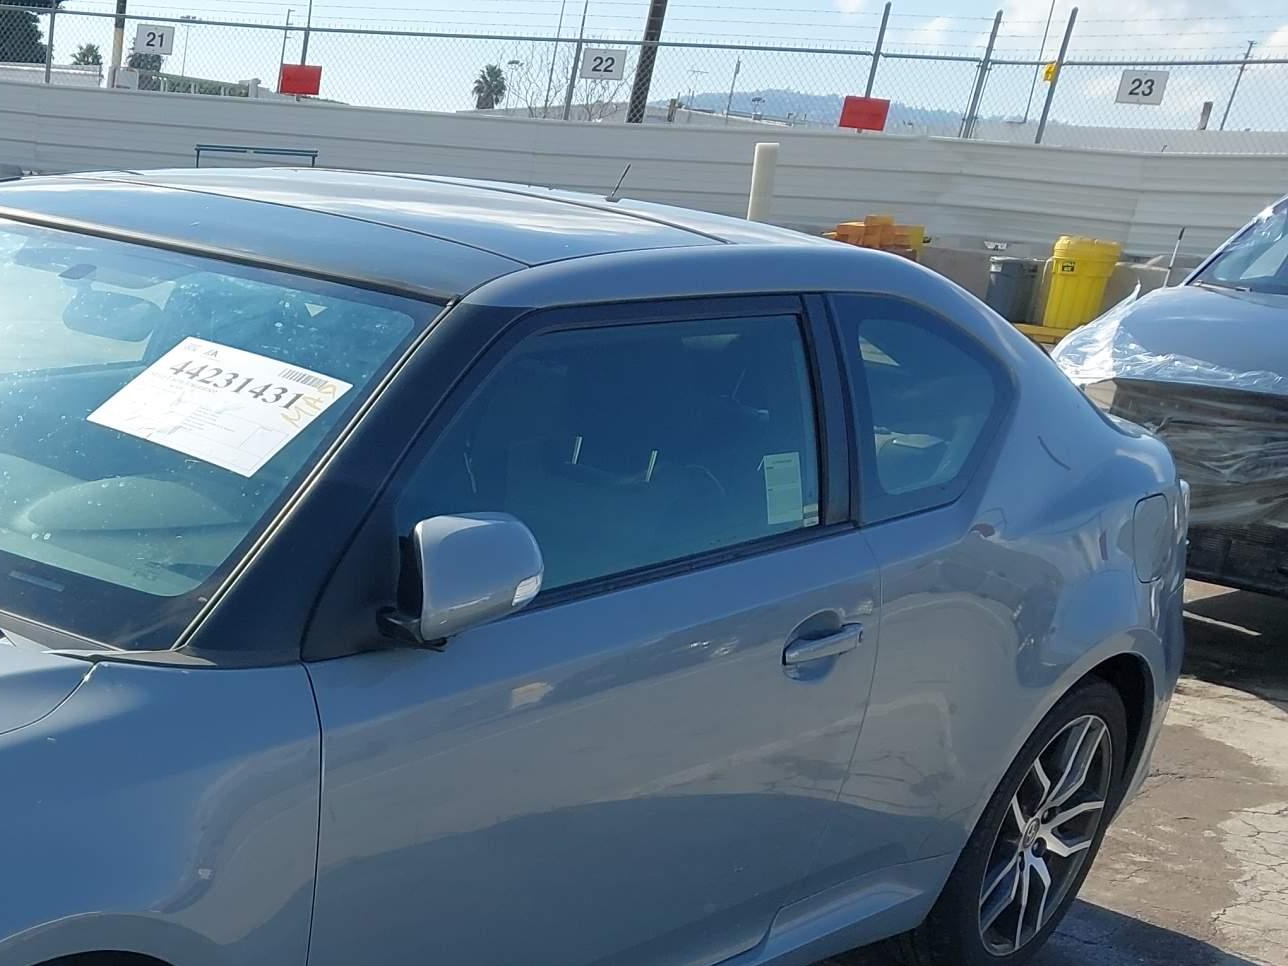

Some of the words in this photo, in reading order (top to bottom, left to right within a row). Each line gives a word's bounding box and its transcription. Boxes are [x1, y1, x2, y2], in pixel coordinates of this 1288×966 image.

[146, 32, 165, 48] 21
[591, 56, 616, 73] 22
[1128, 78, 1155, 97] 23
[169, 360, 305, 409] 44231431
